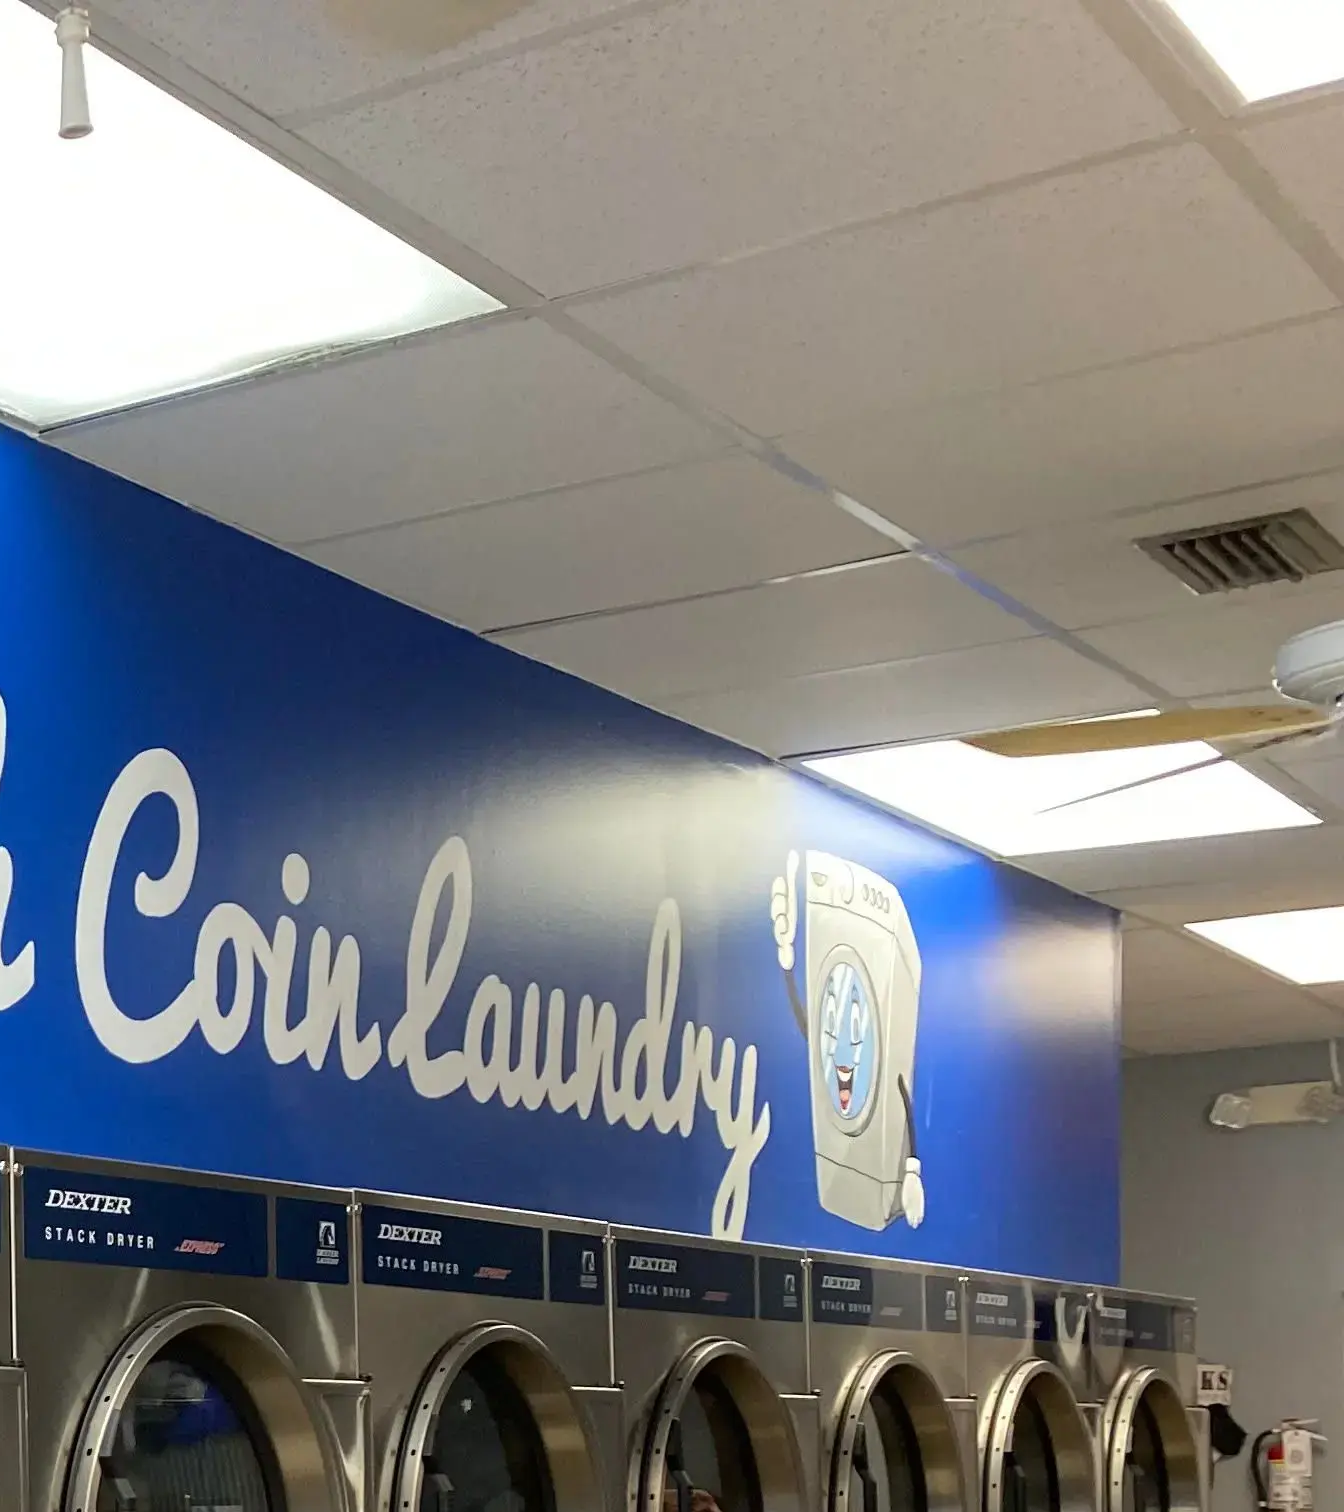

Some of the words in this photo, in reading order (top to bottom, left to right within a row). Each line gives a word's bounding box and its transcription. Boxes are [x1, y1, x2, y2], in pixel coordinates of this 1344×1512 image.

[75, 748, 384, 1080] Coin
[387, 836, 770, 1241] Laundry
[45, 1189, 132, 1215] DEXTER
[45, 1225, 97, 1244] STACK
[107, 1232, 155, 1250] DRYER
[378, 1223, 442, 1246] DEXTER
[378, 1255, 416, 1271] STACK
[423, 1260, 459, 1275] DRYER
[628, 1256, 677, 1273] DEXTER
